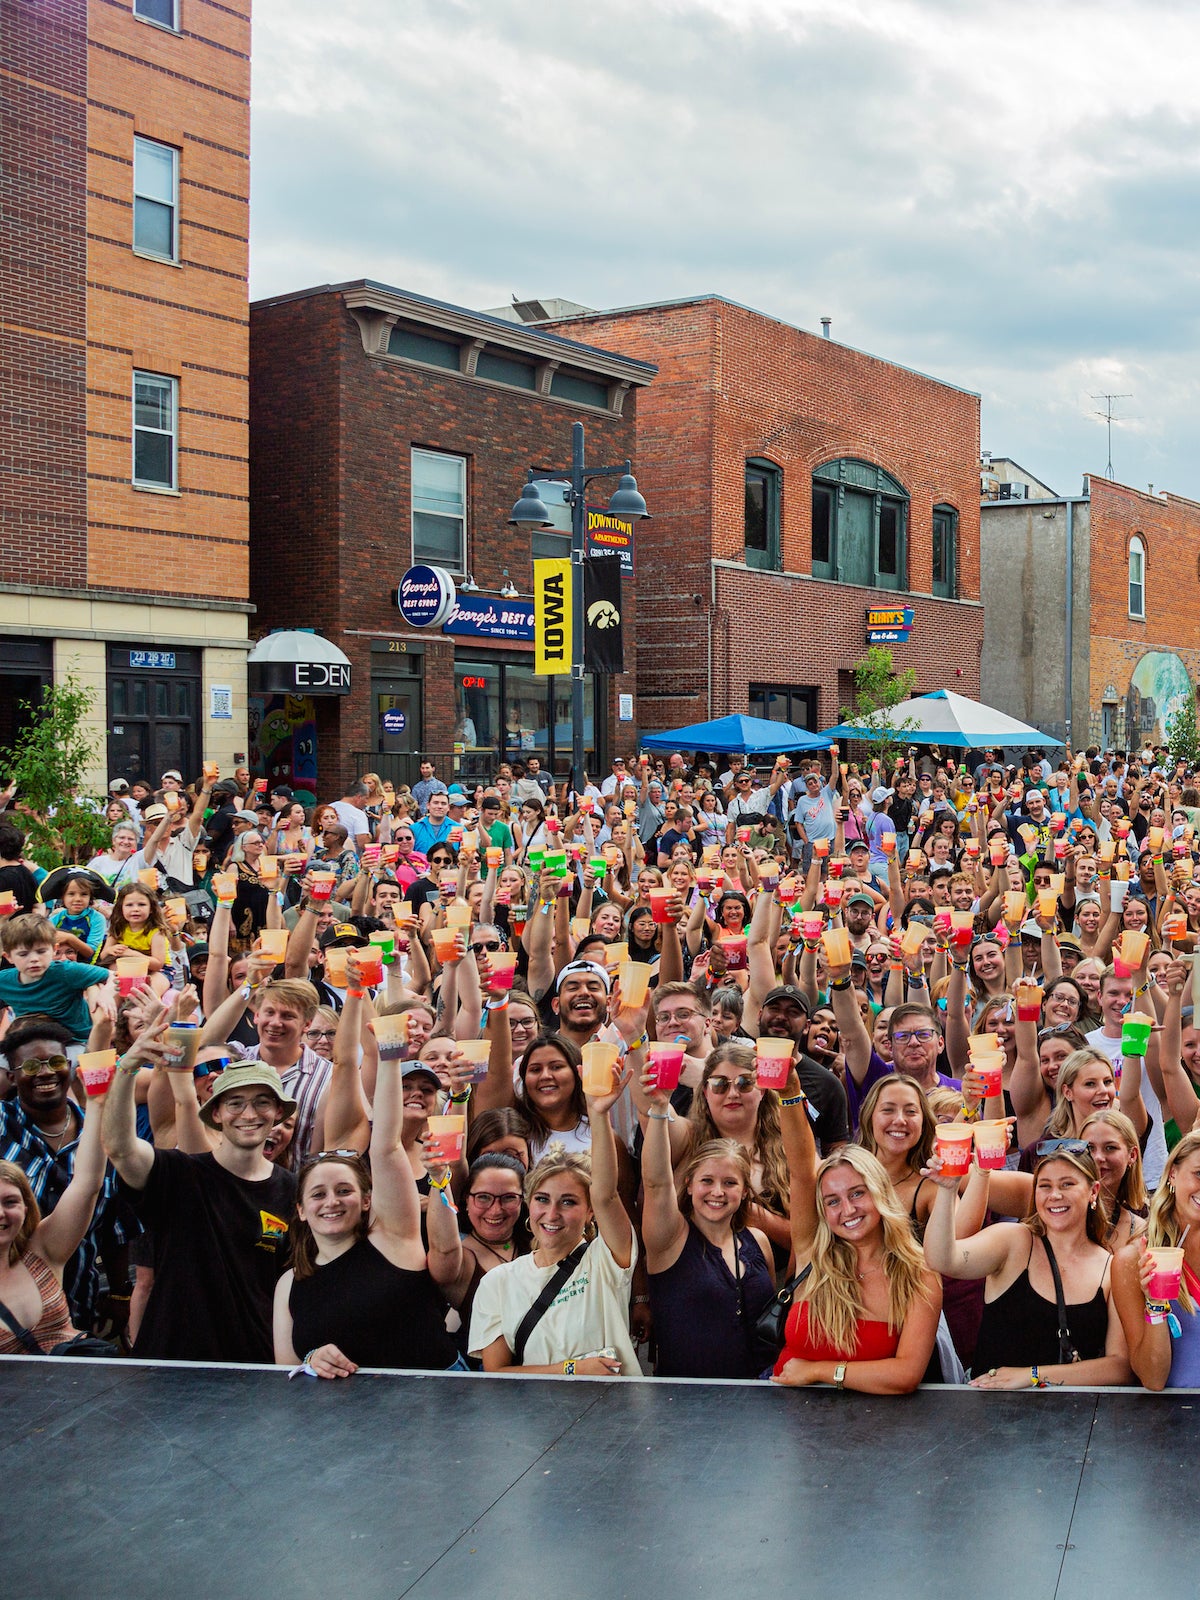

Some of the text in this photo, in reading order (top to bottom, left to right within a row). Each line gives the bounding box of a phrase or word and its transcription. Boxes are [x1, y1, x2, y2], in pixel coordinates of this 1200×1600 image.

[588, 511, 632, 536] DOWNTOWN
[593, 533, 628, 546] APARTMENTS
[401, 578, 439, 598] George's
[403, 599, 438, 608] BEST GYROS
[447, 603, 498, 627] George's
[500, 611, 525, 624] BEST
[543, 573, 564, 661] IOWA
[388, 641, 407, 652] 213
[134, 652, 145, 661] 221
[295, 664, 351, 687] EDEN
[462, 676, 486, 688] OPN
